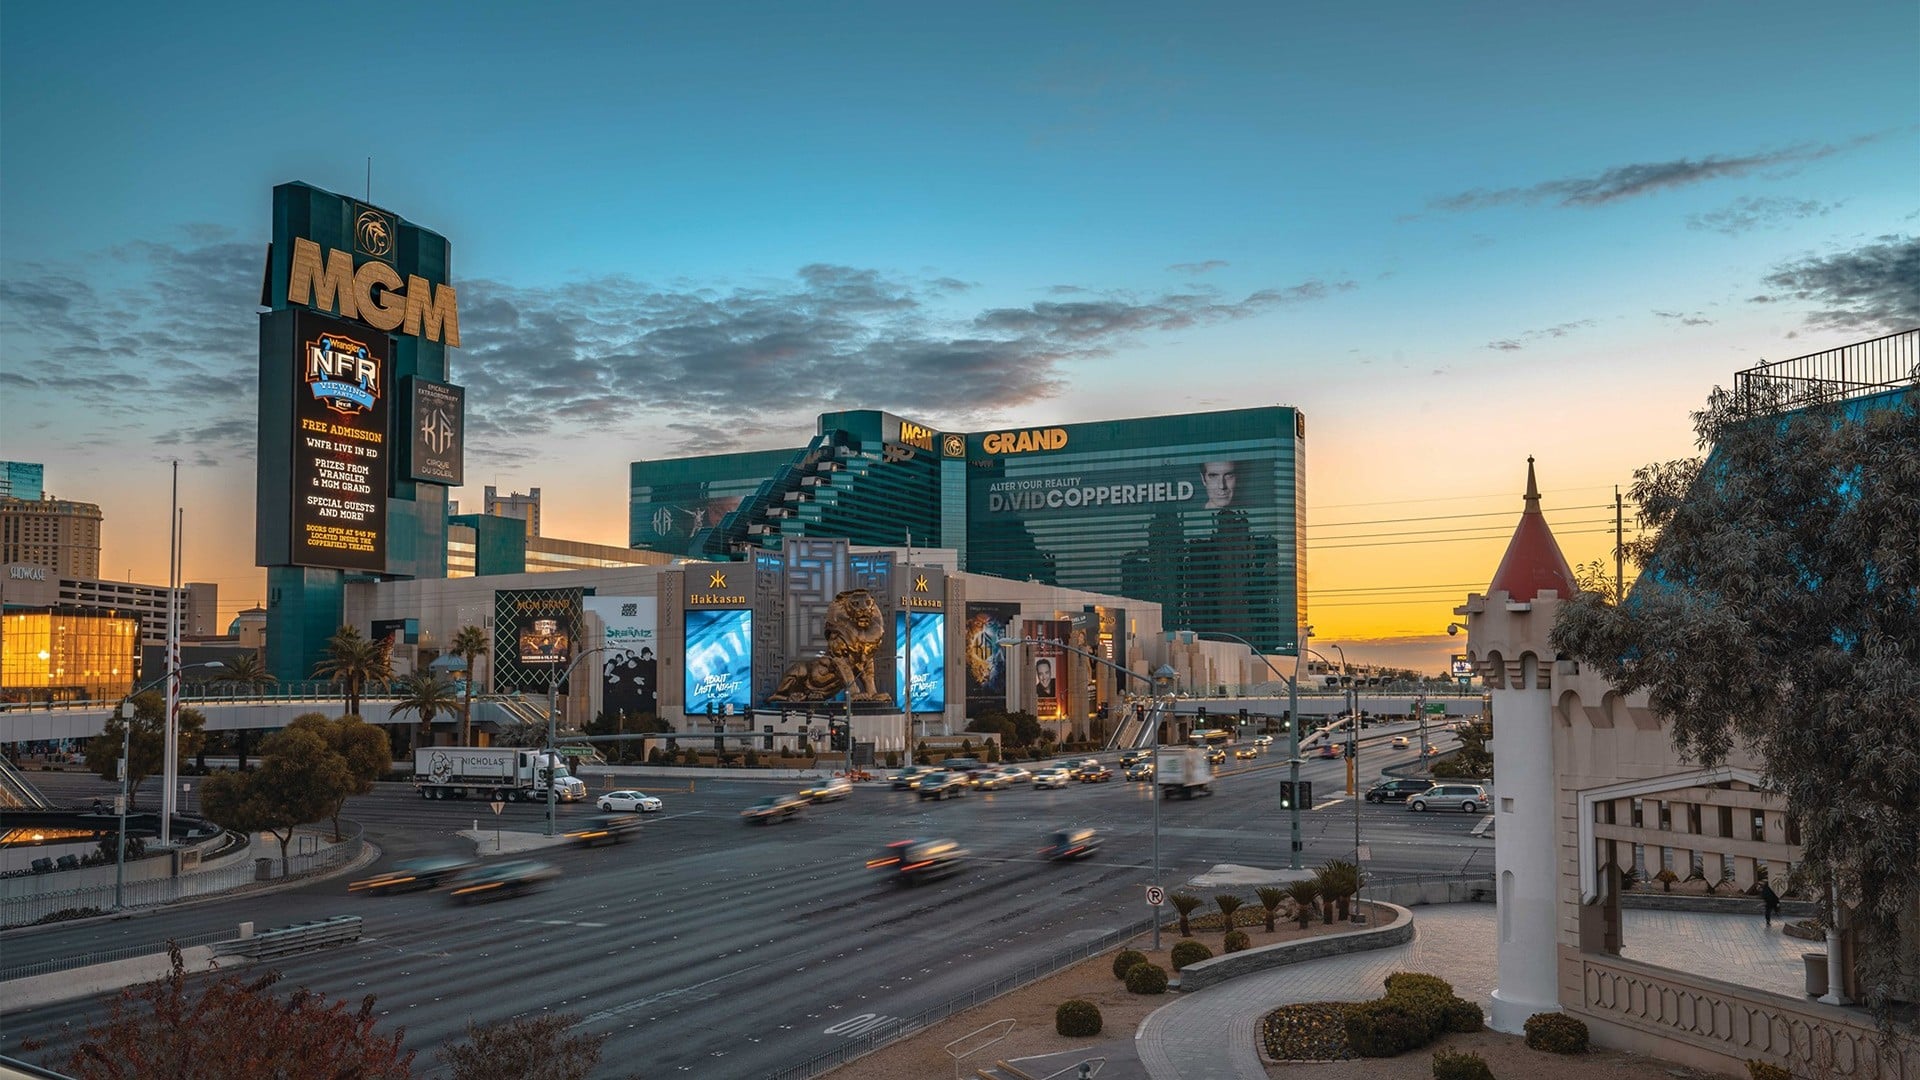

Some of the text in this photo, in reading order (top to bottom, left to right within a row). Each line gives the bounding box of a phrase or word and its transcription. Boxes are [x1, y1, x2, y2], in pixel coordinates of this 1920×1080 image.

[288, 237, 461, 348] MGM
[330, 338, 360, 354] Wrangler
[310, 347, 377, 391] NFR
[320, 382, 367, 398] VIEWING
[302, 419, 382, 443] FREE ADMISSION
[901, 422, 933, 452] MGM
[306, 437, 378, 458] WNFR LIVE IN HD
[982, 428, 1069, 455] GRAND
[315, 458, 369, 475] PRIZES FROM
[426, 459, 450, 470] CIRQUE
[319, 469, 365, 483] WRANGLER
[433, 468, 454, 478] SOLEIL
[321, 479, 340, 490] MGM
[342, 482, 371, 494] GRAND
[990, 477, 1082, 492] ALTER YOUR REALITY
[307, 495, 375, 512] SPECIAL GUESTS
[319, 507, 364, 521] AND MORE!
[306, 524, 327, 533] DOORS
[328, 526, 345, 535] OPEN
[367, 531, 376, 539] PM
[311, 532, 372, 545] LOCATED INSIDE THE
[307, 538, 375, 552] COPPERFIELD THEATER
[10, 566, 46, 580] SHOWCASE
[517, 600, 570, 610] MGM GRAND
[691, 594, 746, 604] Hakkasan
[704, 672, 731, 684] ABOUT
[694, 683, 716, 696] LAST
[462, 757, 503, 766] NICHOLAS
